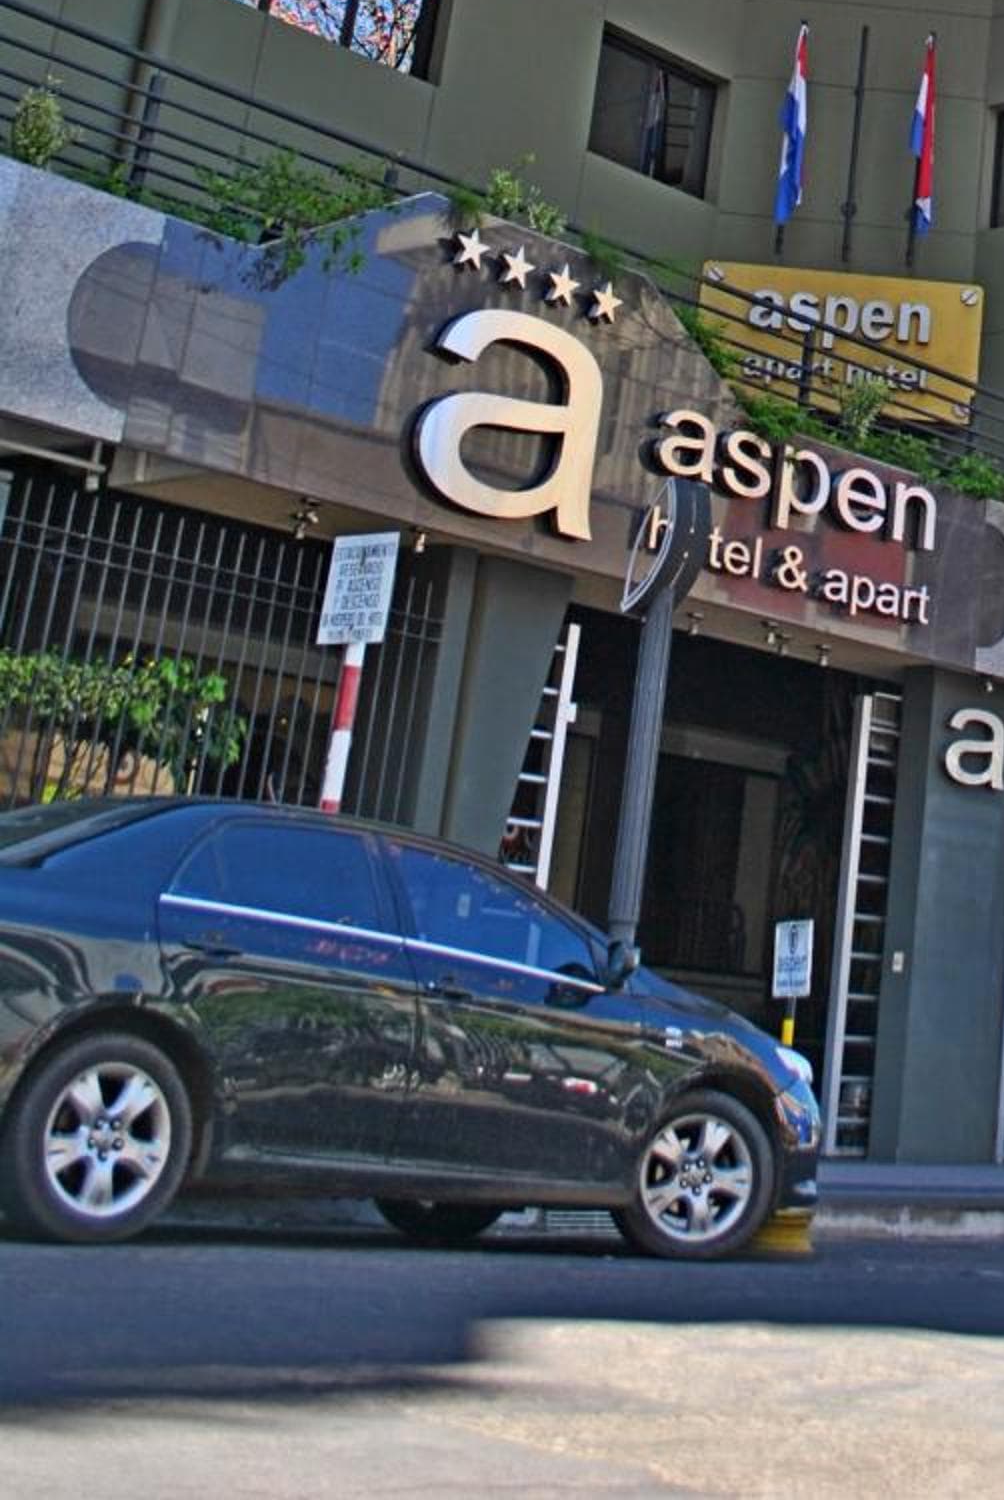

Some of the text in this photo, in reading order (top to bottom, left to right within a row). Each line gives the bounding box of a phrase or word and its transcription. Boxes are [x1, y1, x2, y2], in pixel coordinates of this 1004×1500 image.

[742, 355, 833, 385] apat
[749, 288, 932, 349] aspen
[416, 308, 603, 542] a
[658, 409, 937, 551] aspen
[648, 504, 931, 625] htel & apart
